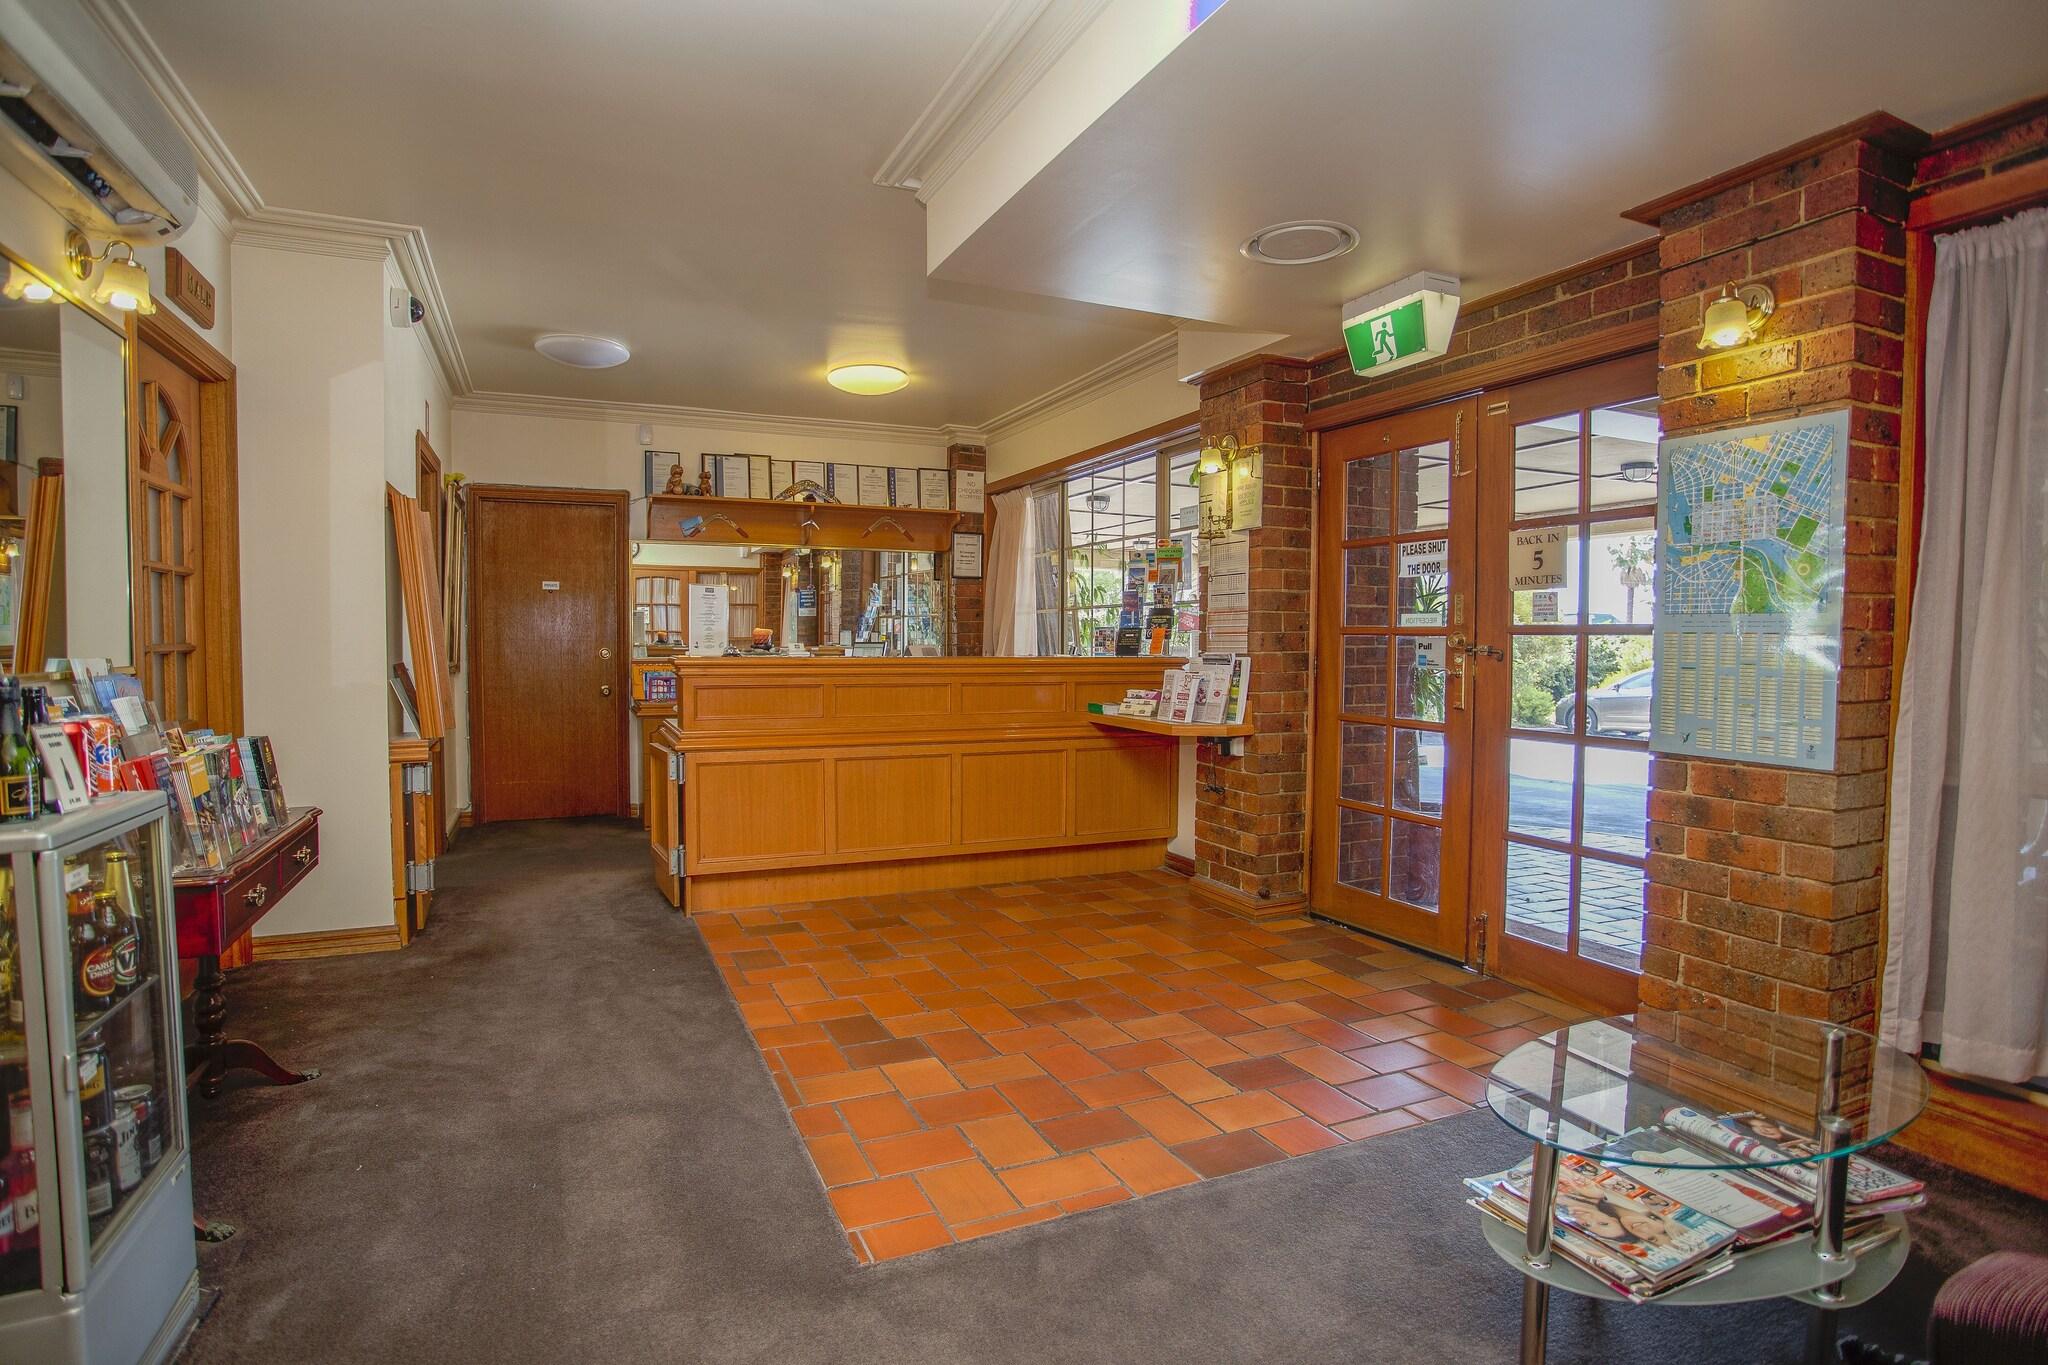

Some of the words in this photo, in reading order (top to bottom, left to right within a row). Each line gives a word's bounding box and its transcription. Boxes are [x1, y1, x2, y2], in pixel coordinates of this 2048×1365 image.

[1517, 534, 1543, 546] BACK
[1548, 532, 1560, 543] IN
[1402, 543, 1427, 557] PLEASE
[1428, 541, 1447, 553] SHUT
[1532, 550, 1544, 570] 5
[1407, 563, 1421, 575] THE
[1422, 562, 1441, 574] DOOR
[1515, 575, 1563, 586] MINUTES
[1418, 642, 1432, 650] Pull
